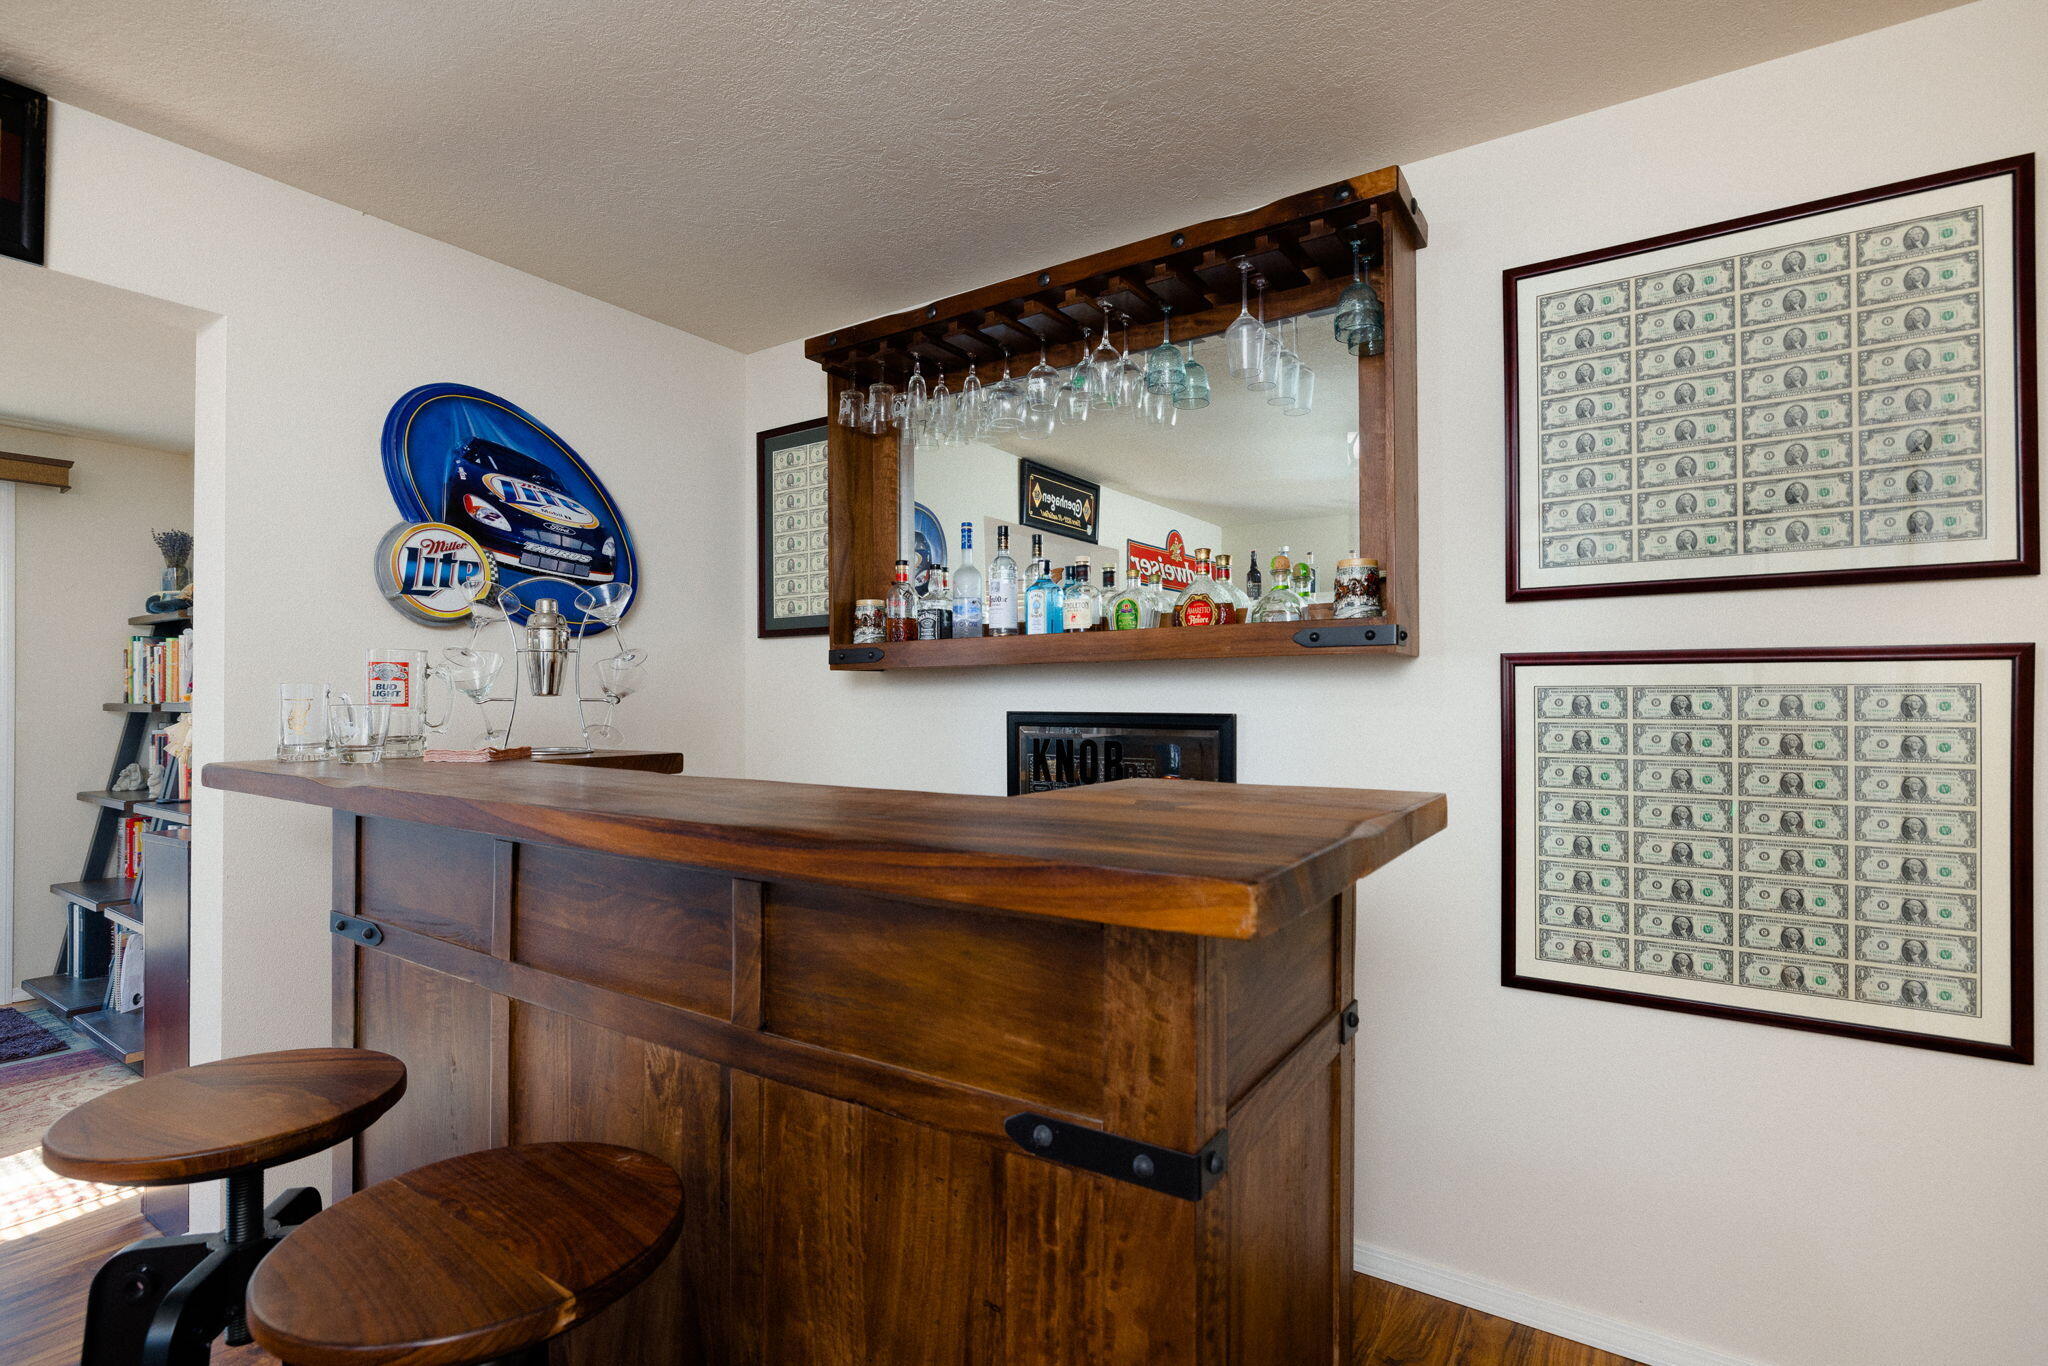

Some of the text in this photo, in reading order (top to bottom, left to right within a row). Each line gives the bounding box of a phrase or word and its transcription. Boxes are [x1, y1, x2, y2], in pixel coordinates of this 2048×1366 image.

[482, 512, 501, 522] 2
[550, 524, 570, 533] Ford
[420, 538, 468, 555] Miller
[523, 541, 593, 563] TAURUS
[399, 547, 480, 596] Lite
[1033, 738, 1123, 784] KNOB
